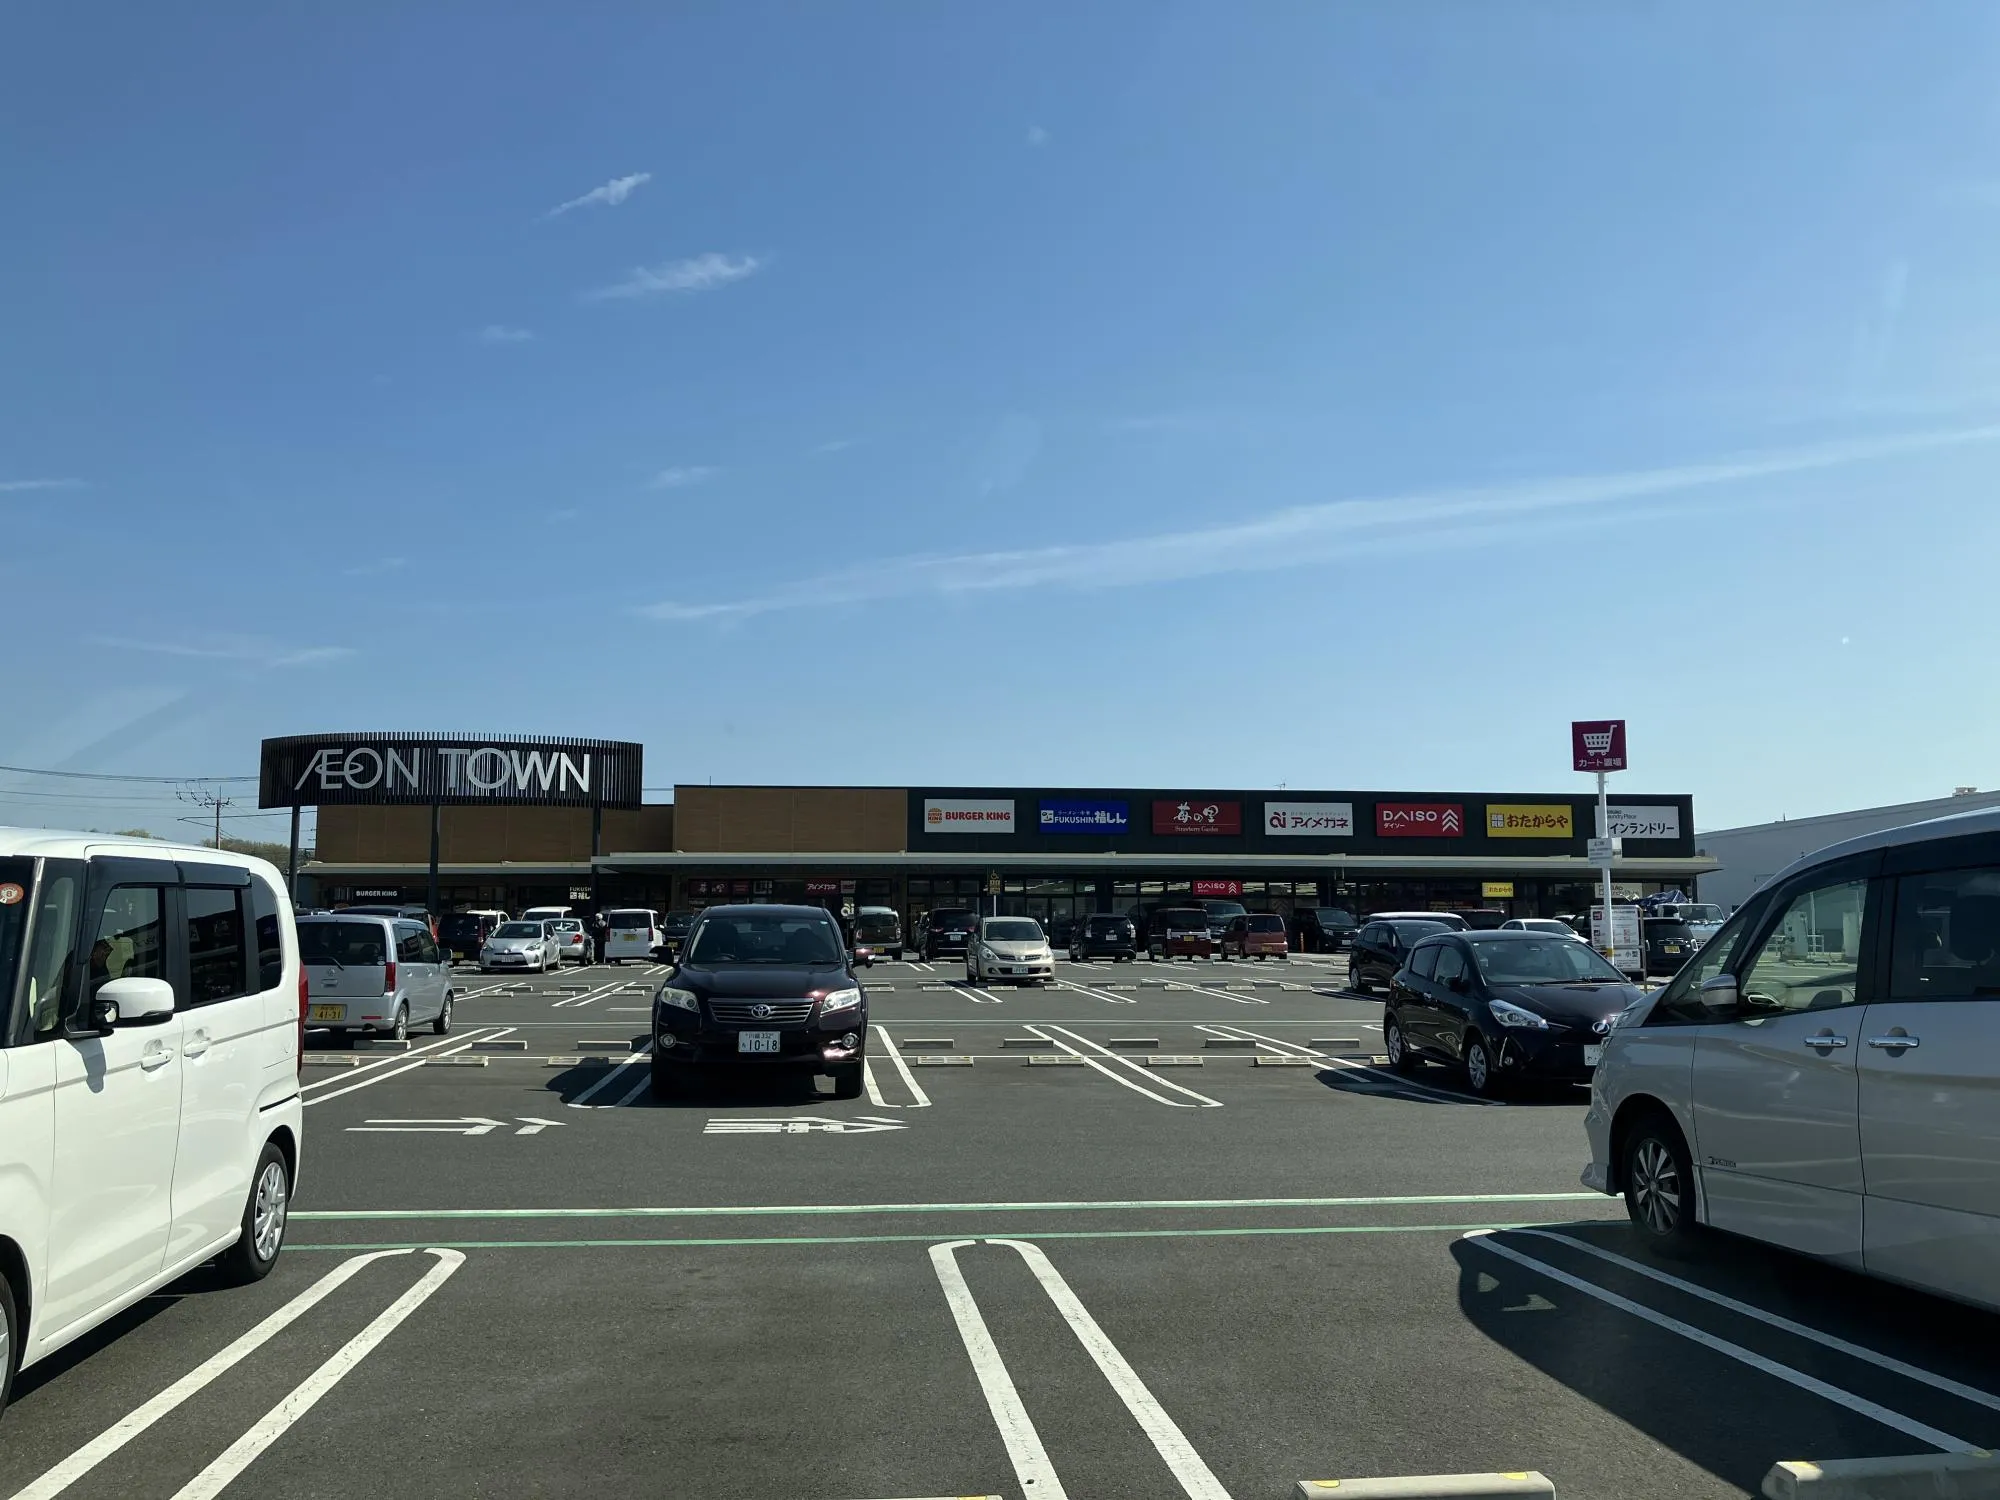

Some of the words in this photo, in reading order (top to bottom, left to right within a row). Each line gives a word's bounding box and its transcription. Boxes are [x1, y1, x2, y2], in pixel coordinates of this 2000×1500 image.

[437, 747, 591, 793] TOWN
[945, 811, 984, 820] BURGER
[986, 811, 1011, 820] KING
[1054, 816, 1094, 824] FUKUSHIN
[1094, 810, 1127, 824] 福しん
[1383, 810, 1437, 822] DAISO
[1506, 813, 1569, 828] おたからや
[1290, 816, 1349, 829] アイメガネ
[1608, 822, 1675, 835] インランドリー
[749, 1039, 778, 1051] 10-18
